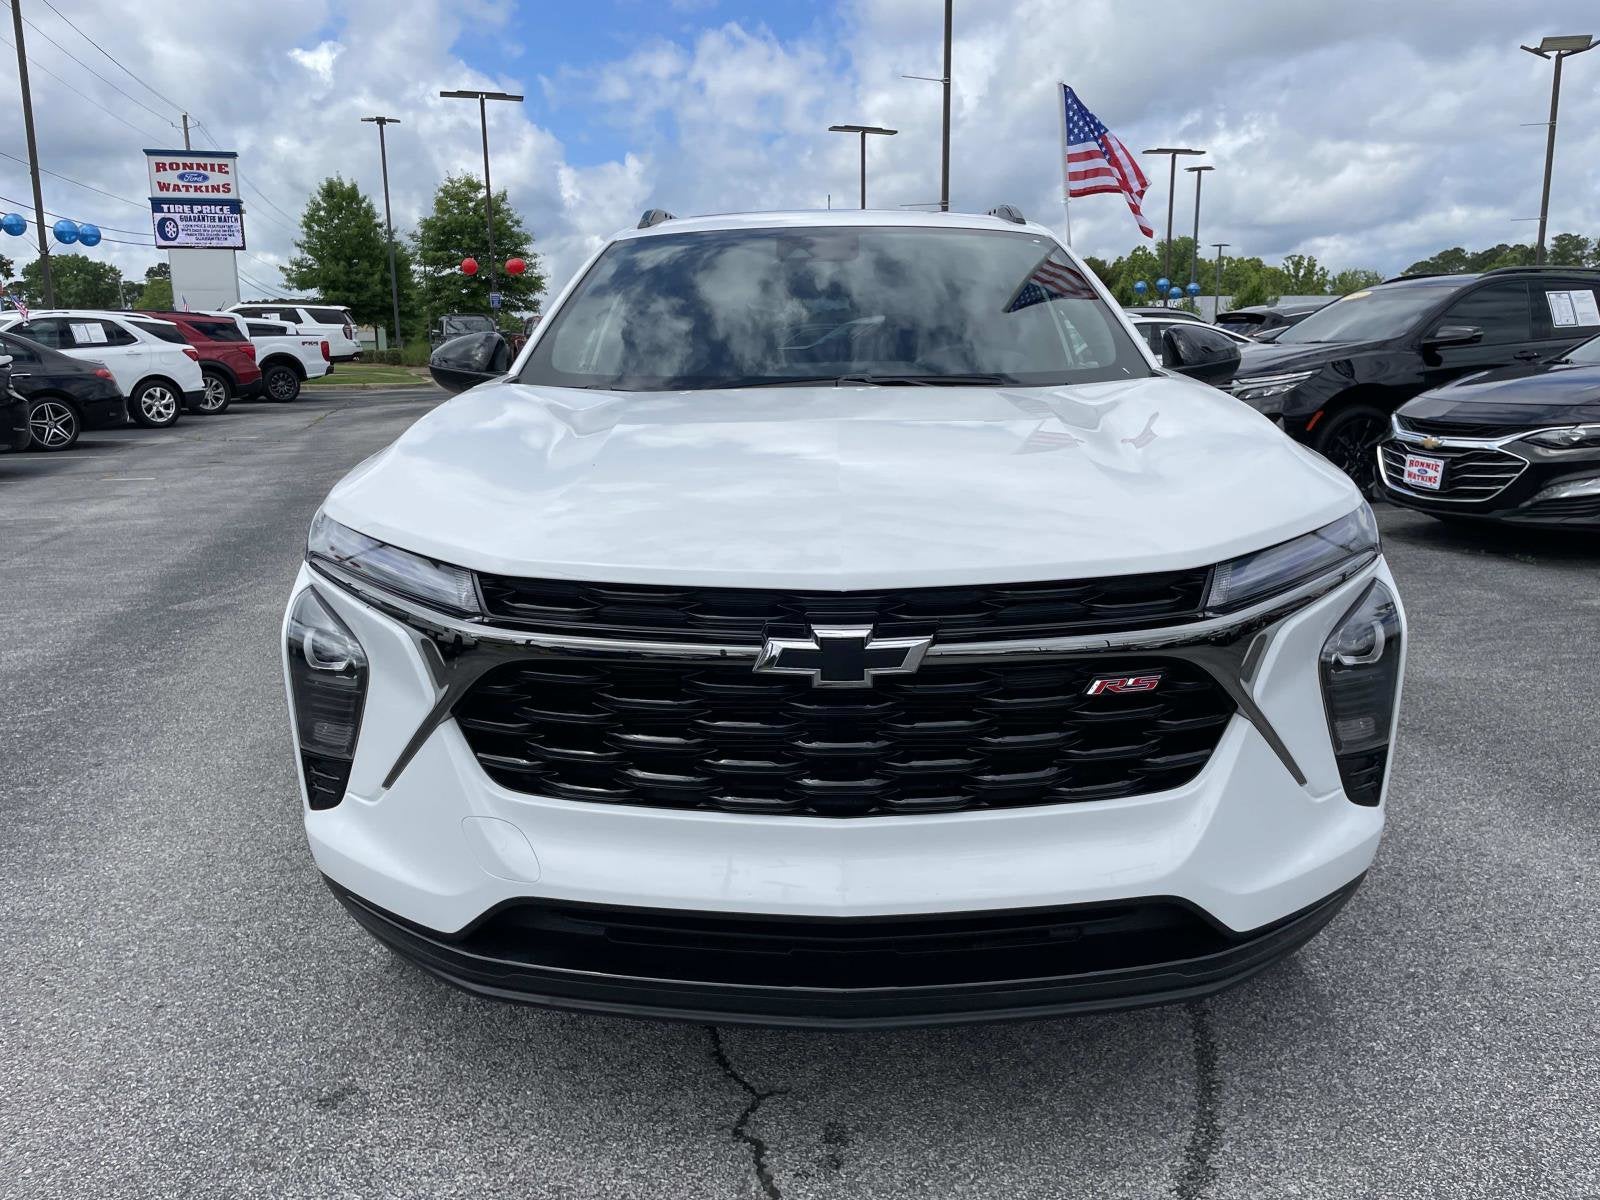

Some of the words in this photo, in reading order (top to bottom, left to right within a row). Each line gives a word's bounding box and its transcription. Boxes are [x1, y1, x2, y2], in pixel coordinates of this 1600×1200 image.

[155, 162, 230, 175] RONNIE
[183, 173, 203, 182] Ford
[157, 181, 232, 194] WATKINS
[161, 204, 192, 214] TIRE
[192, 205, 231, 214] PRICE
[179, 214, 217, 223] GUARANTEE
[217, 215, 239, 224] MATCH
[1408, 459, 1440, 473] RONNIE
[1407, 470, 1438, 484] WATKINS
[1086, 674, 1162, 695] RS
